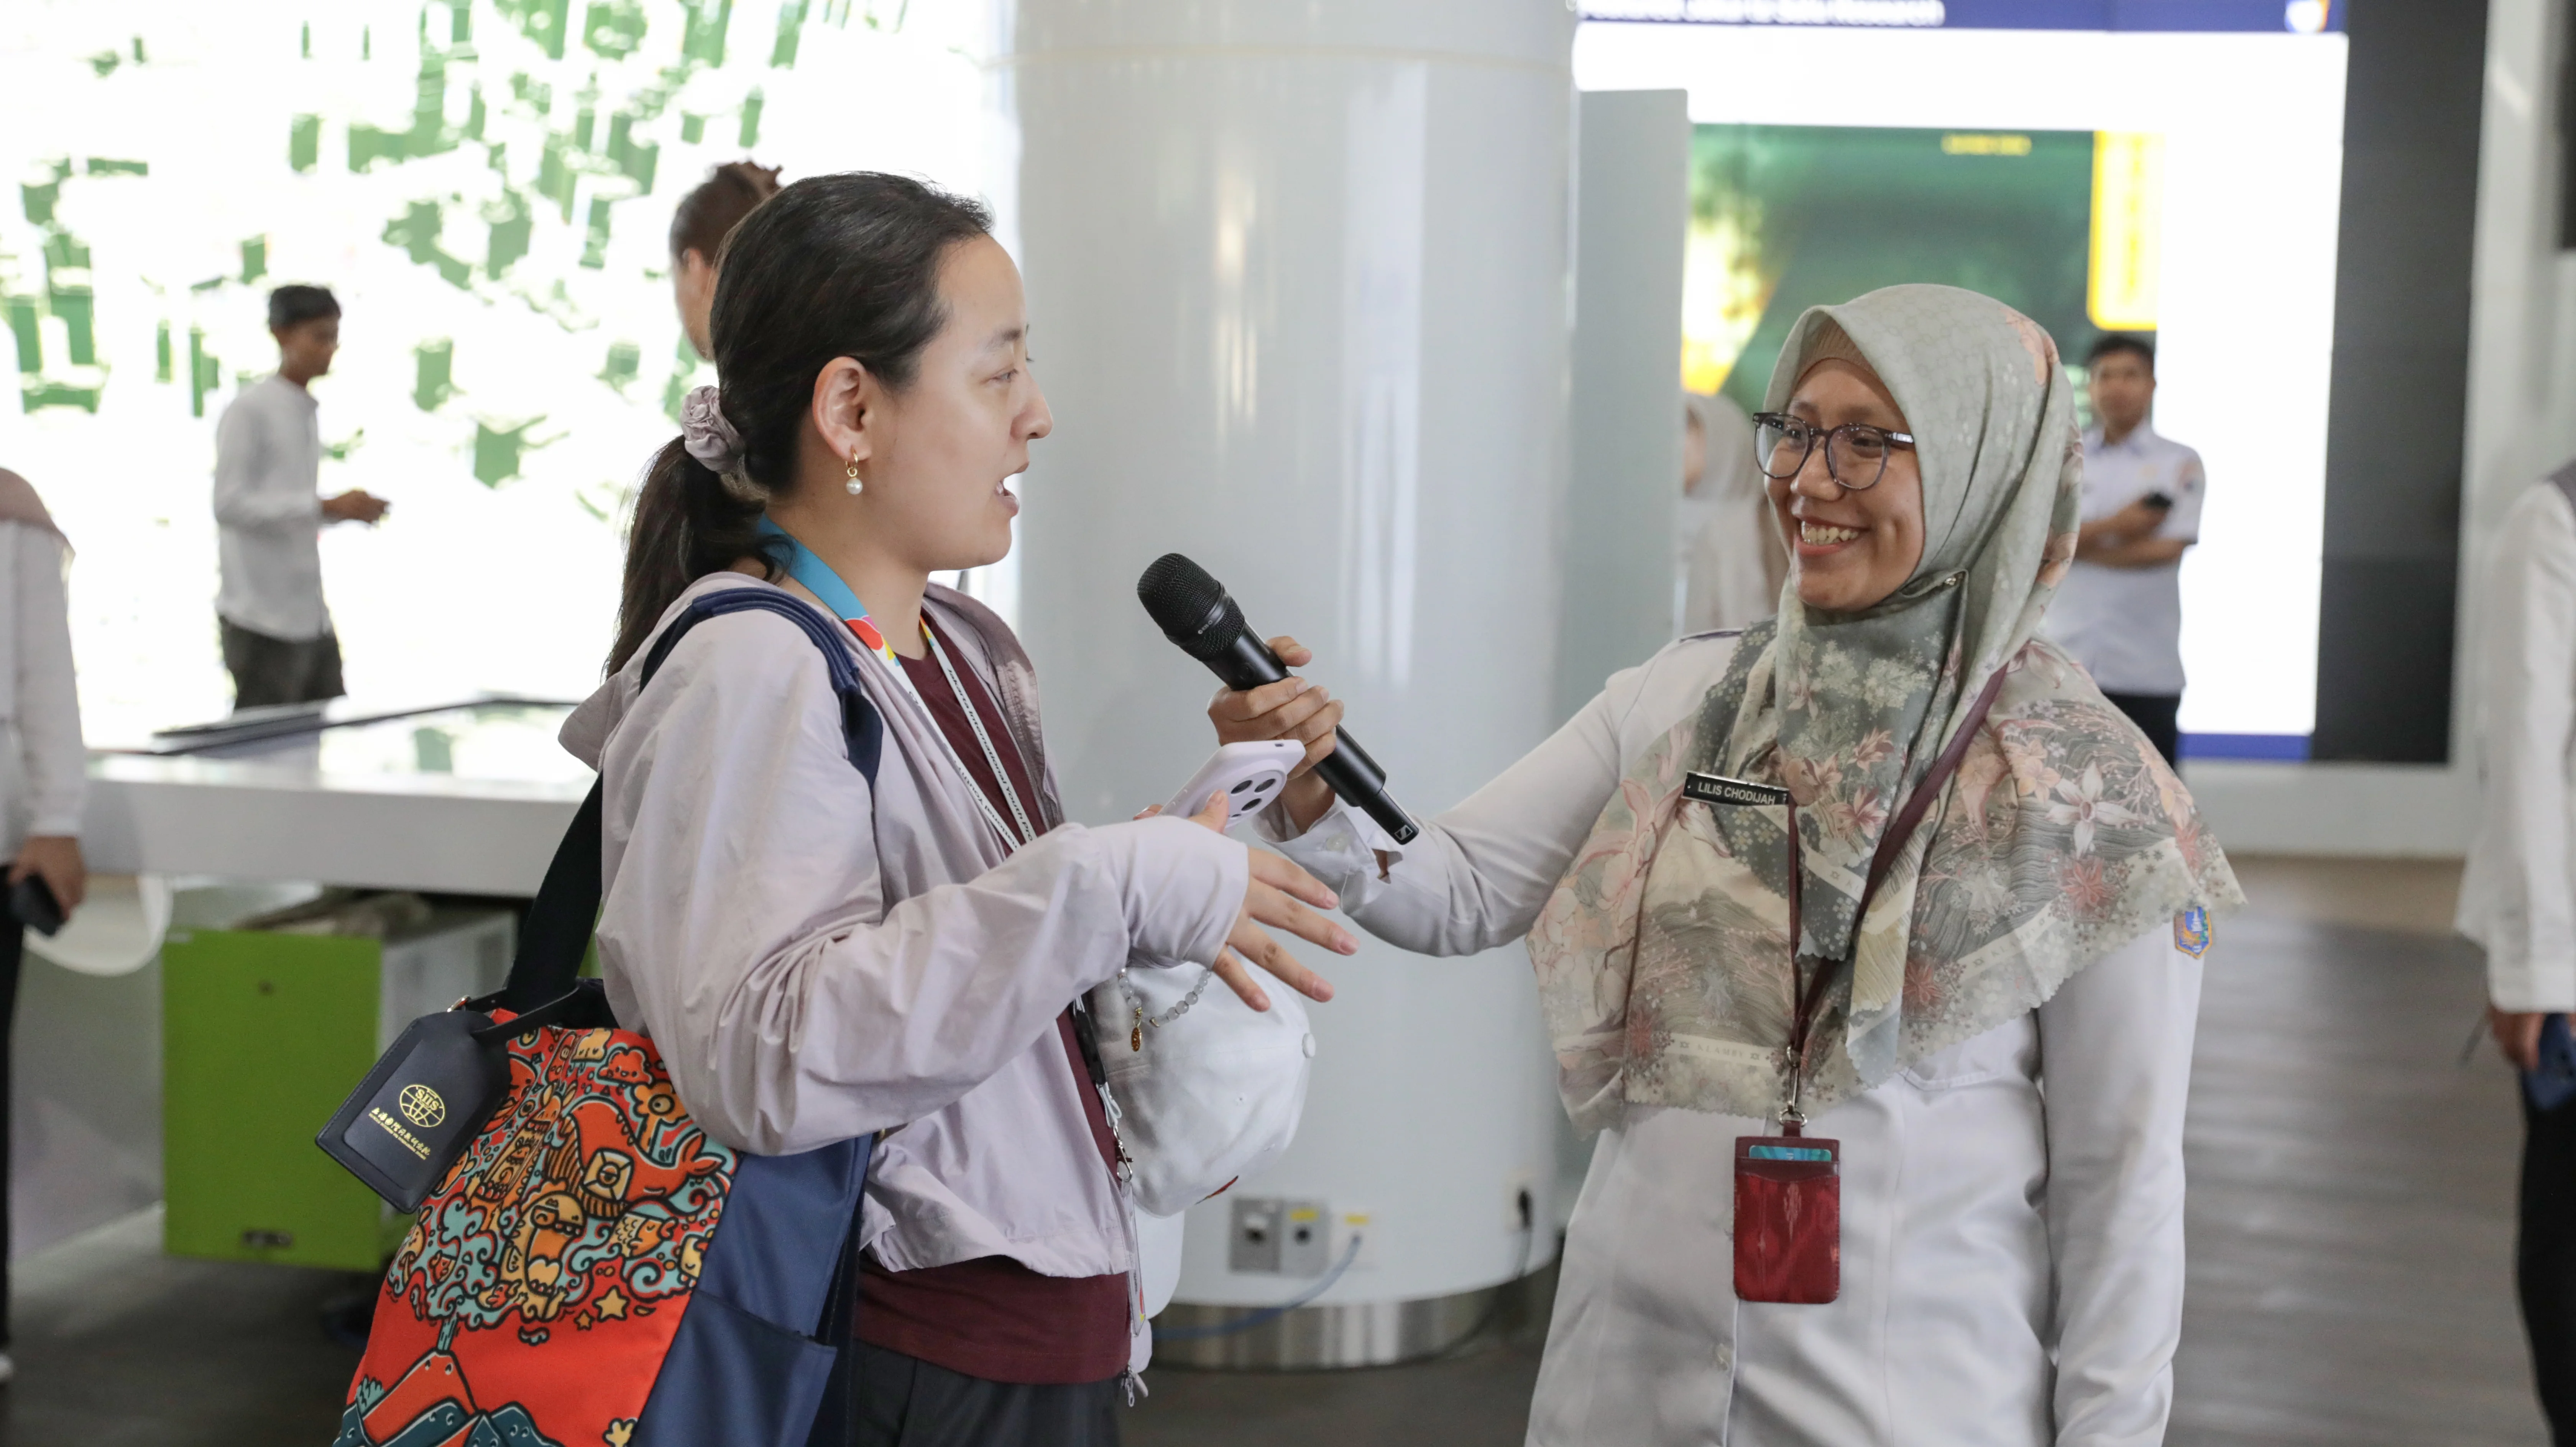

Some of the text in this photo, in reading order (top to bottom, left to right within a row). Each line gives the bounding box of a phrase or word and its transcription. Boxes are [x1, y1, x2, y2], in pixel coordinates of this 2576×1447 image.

[948, 668, 969, 709] Jakarta
[969, 711, 1006, 784] International
[1006, 787, 1023, 819] Youth
[1698, 782, 1776, 805] LILIS CHODIJAH
[985, 806, 1017, 848] national
[416, 1089, 439, 1111] SIIS
